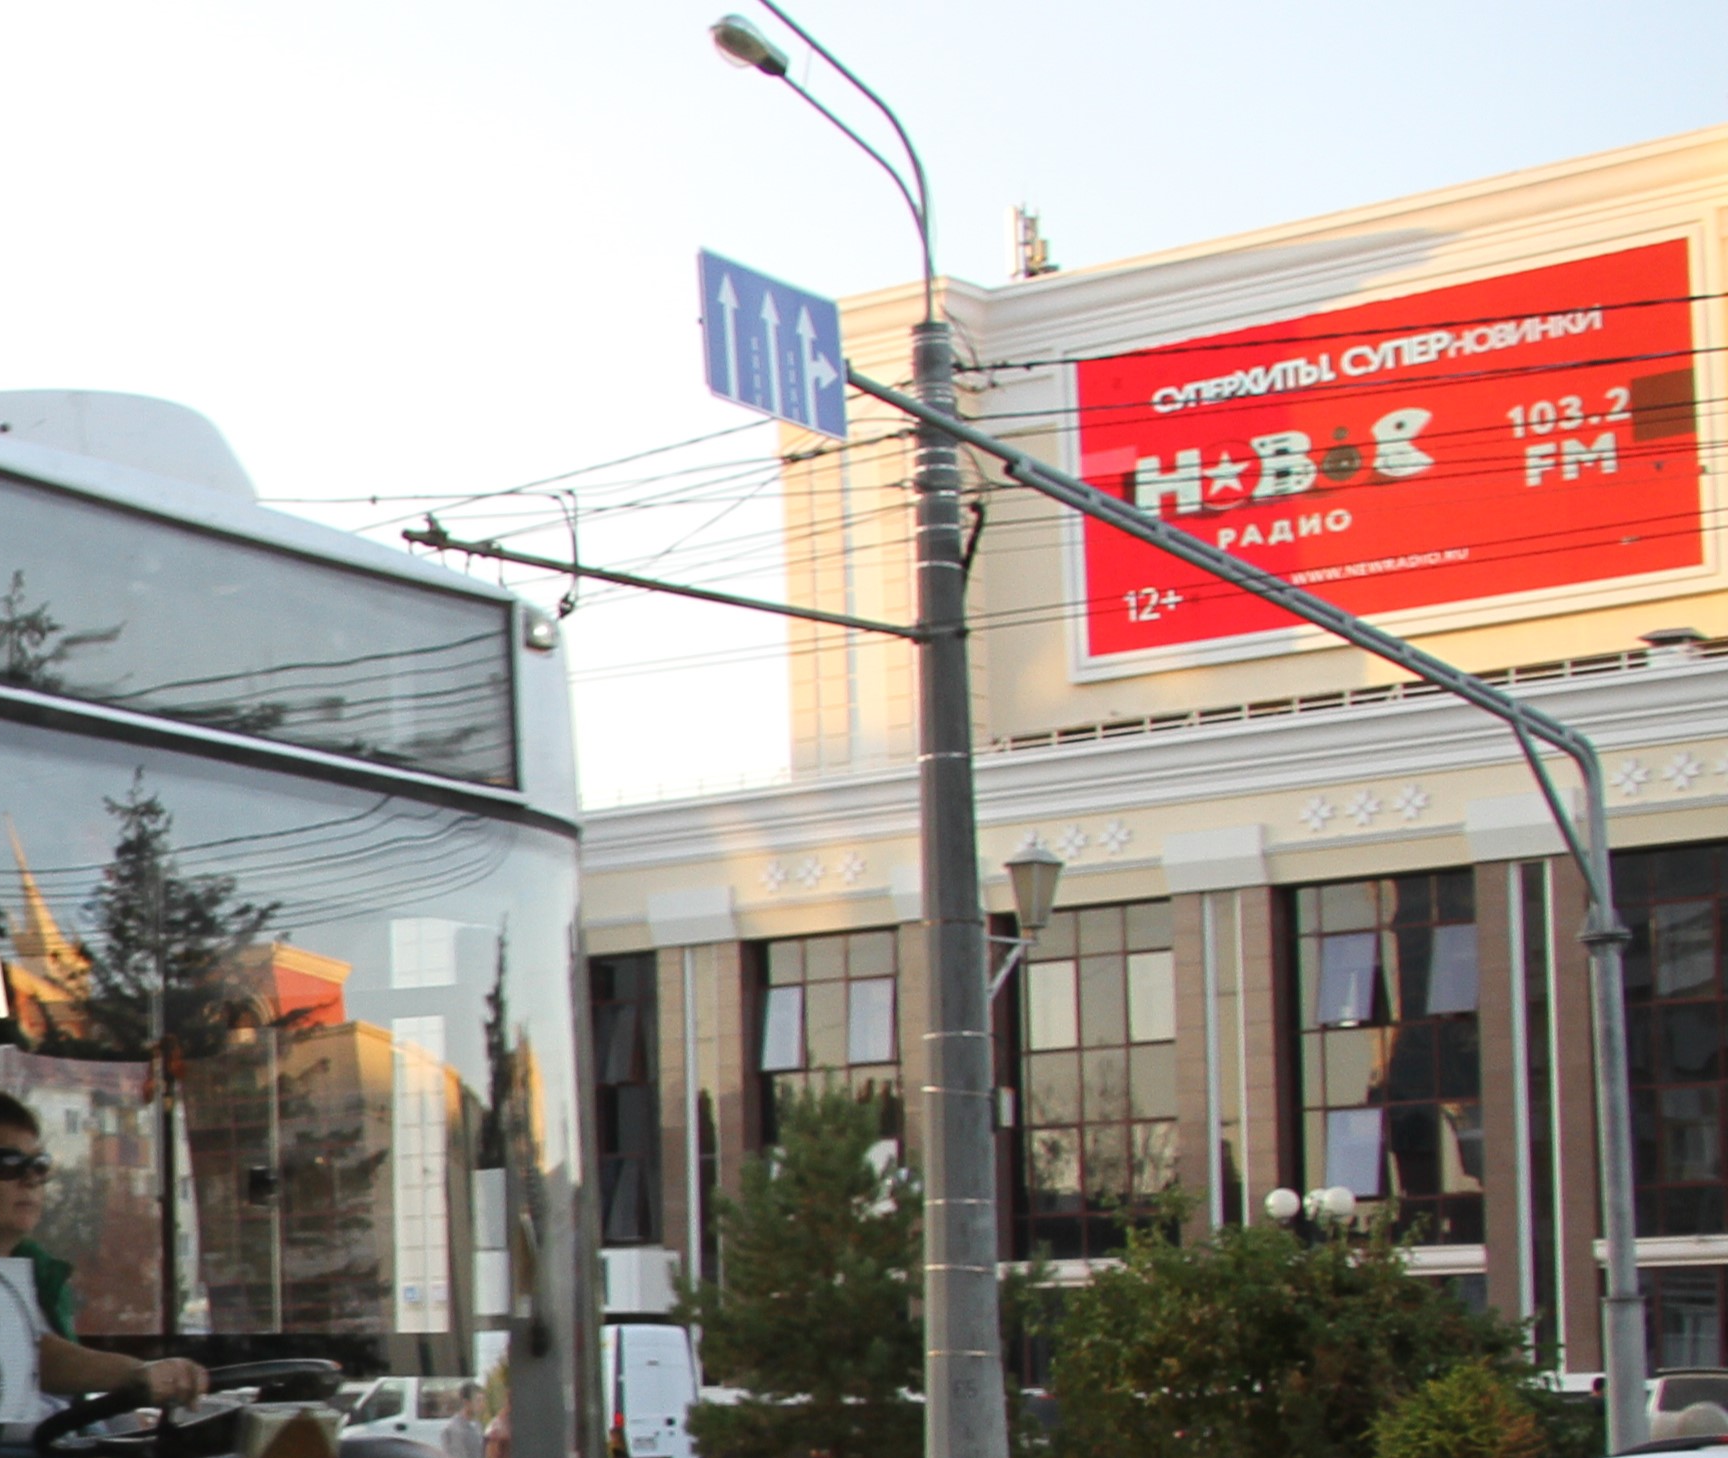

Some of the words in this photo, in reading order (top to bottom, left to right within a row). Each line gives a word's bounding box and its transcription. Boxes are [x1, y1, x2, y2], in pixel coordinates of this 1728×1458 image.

[1341, 306, 1602, 375] СУПЕРНОВИНКИ
[1505, 386, 1630, 438] 103.2
[1524, 431, 1617, 487] FM
[1216, 507, 1353, 549] РАДИО
[1123, 586, 1184, 622] 12+
